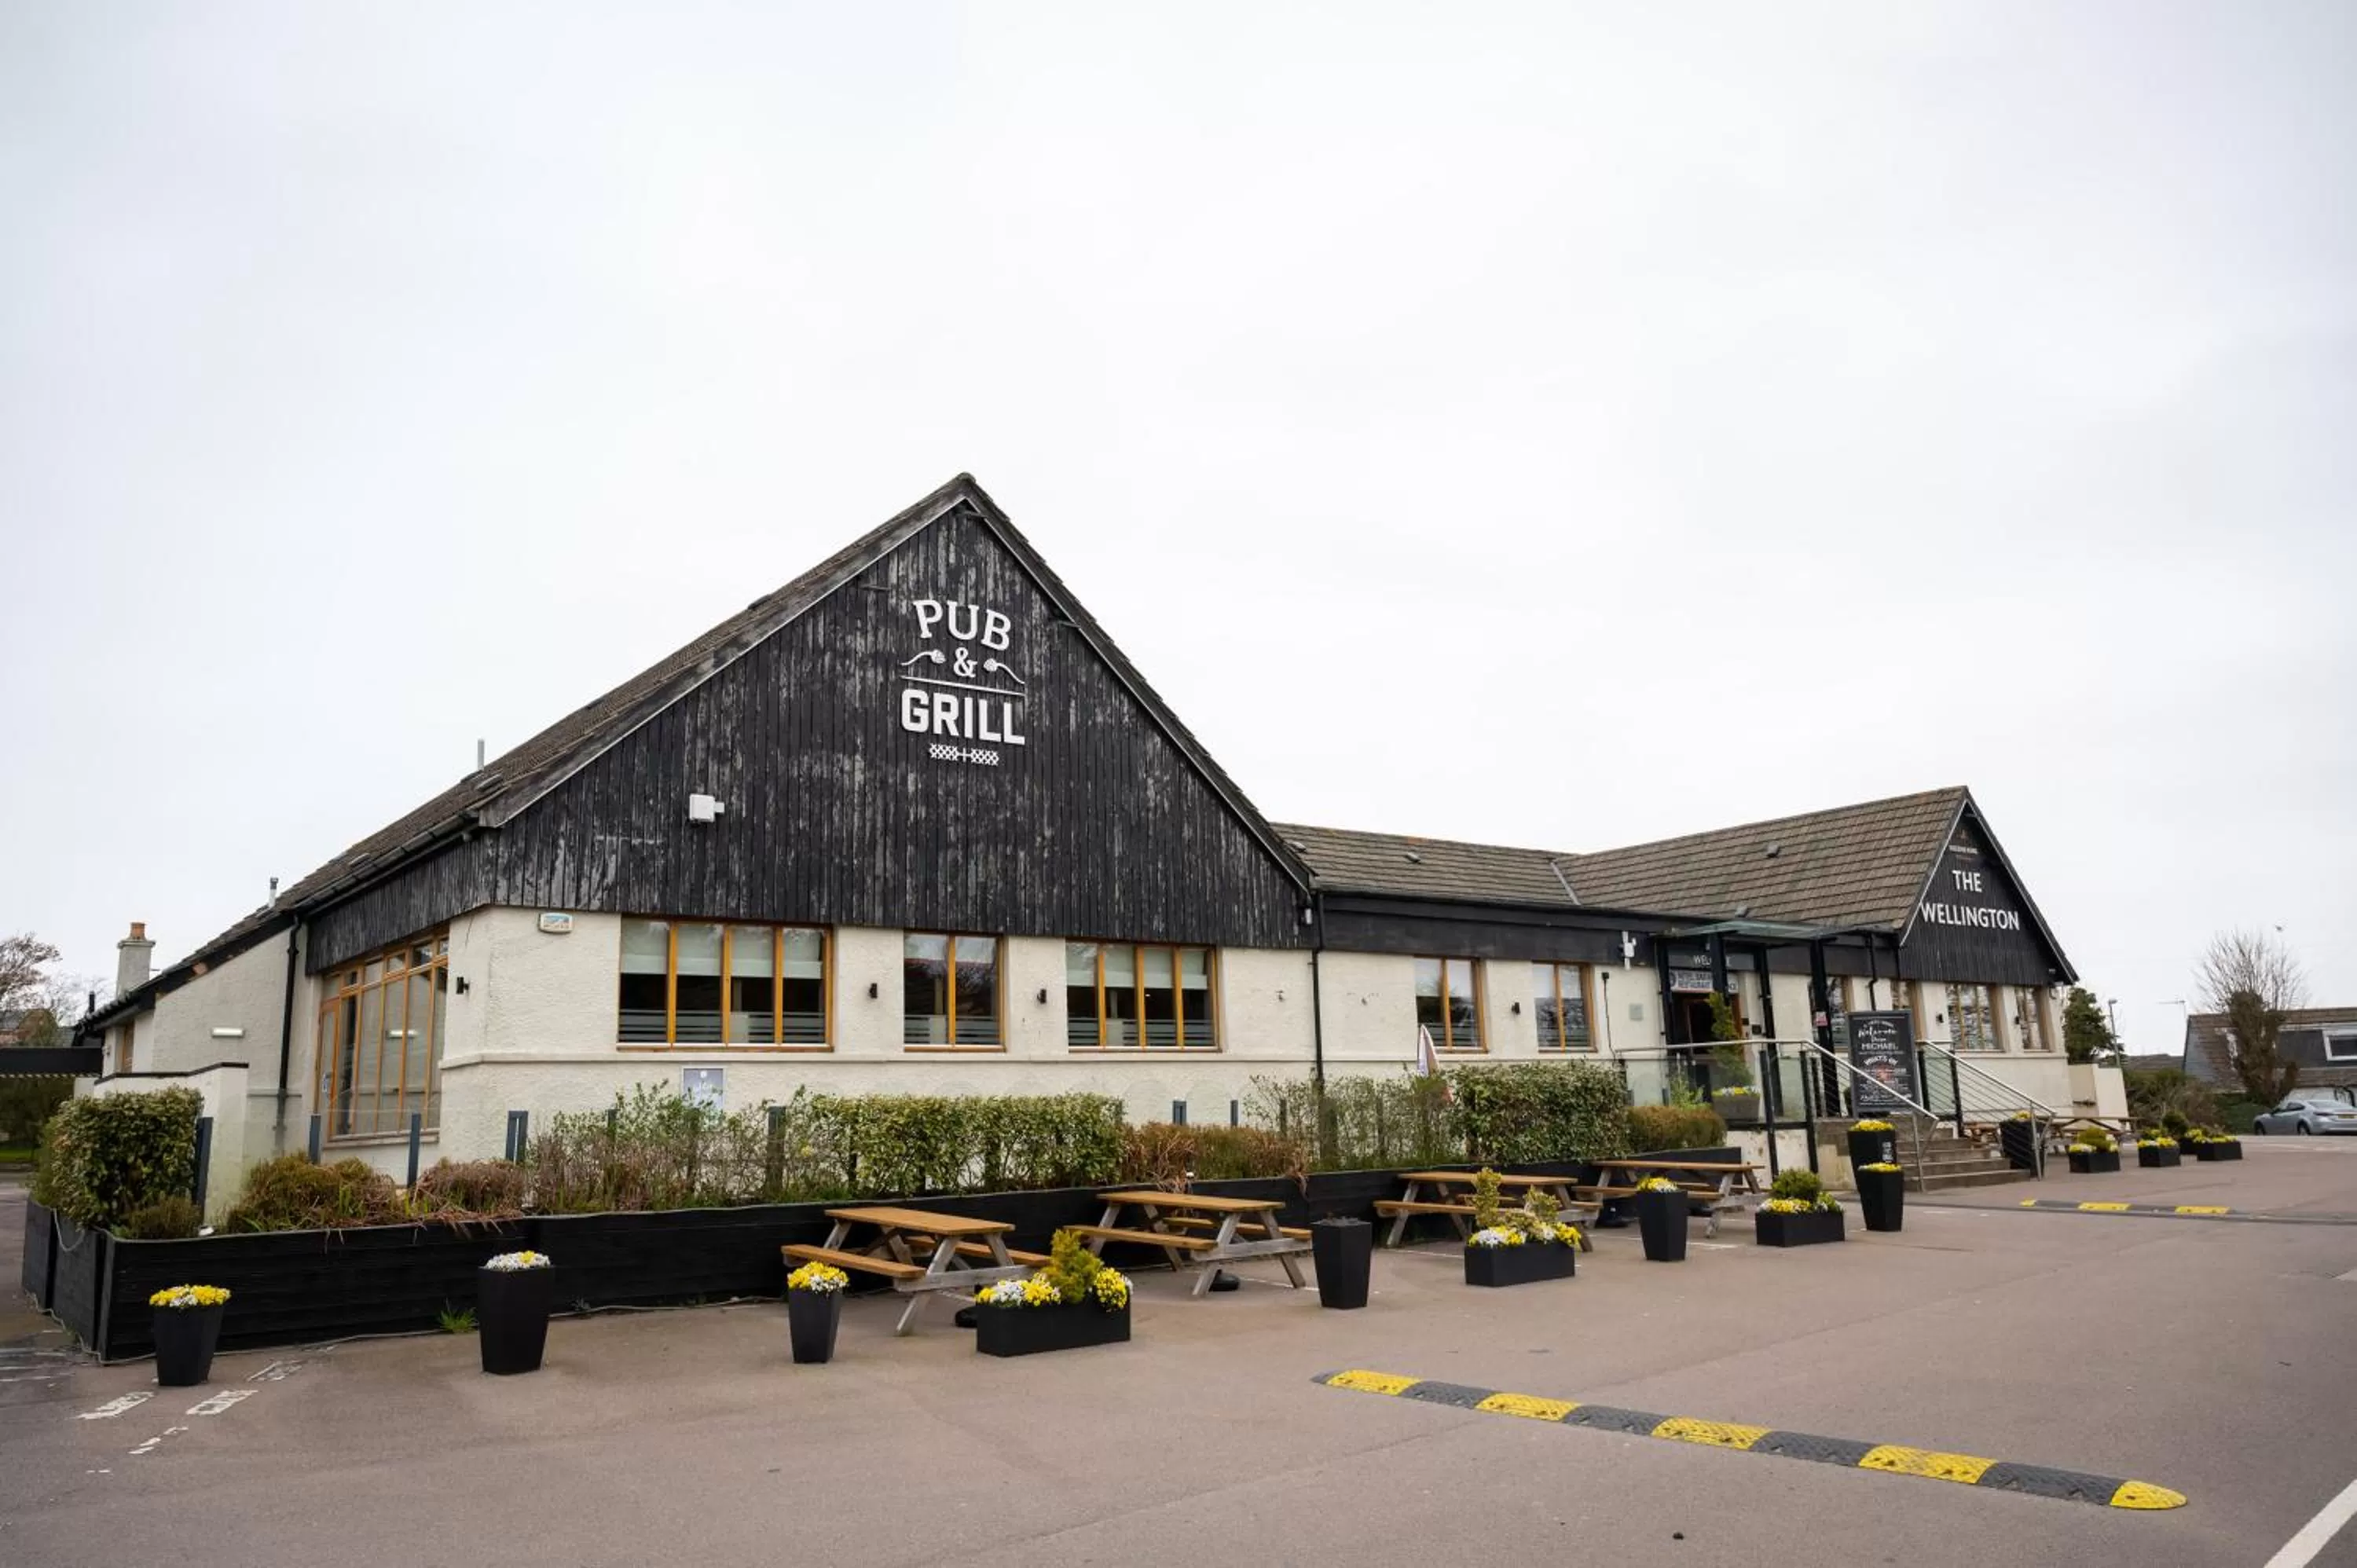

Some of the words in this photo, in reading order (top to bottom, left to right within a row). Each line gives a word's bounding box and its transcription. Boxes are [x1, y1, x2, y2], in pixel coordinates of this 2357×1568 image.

[913, 599, 1011, 650] PUB
[953, 647, 977, 678] &
[901, 689, 1025, 745] GRILL
[1952, 870, 1982, 892] THE
[1920, 903, 2020, 930] WELLINGTON
